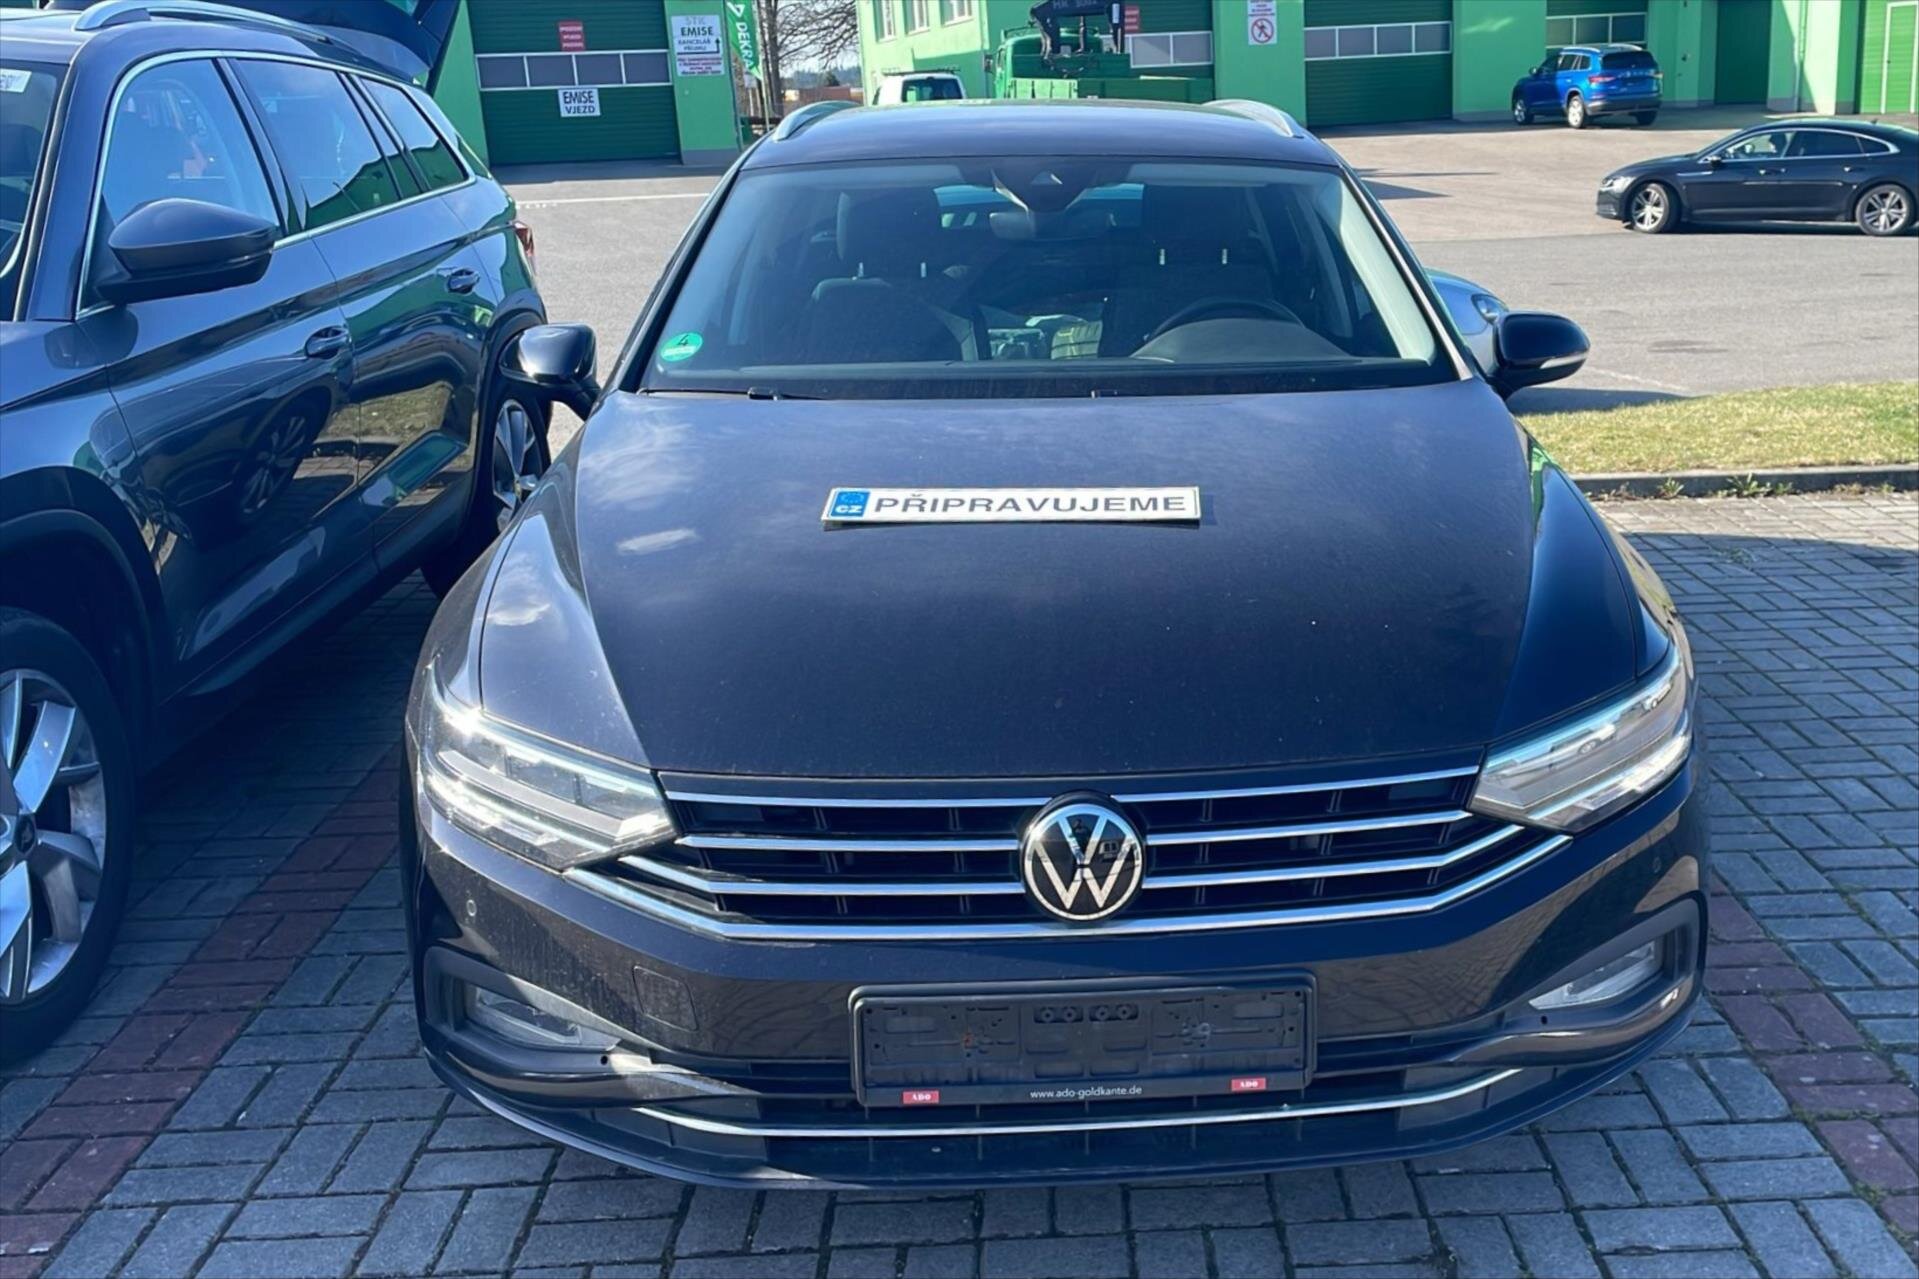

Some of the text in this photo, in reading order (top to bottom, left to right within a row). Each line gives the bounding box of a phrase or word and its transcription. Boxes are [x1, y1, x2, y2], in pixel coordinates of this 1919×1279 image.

[680, 26, 714, 37] EMISE
[736, 22, 754, 69] DEKRA
[563, 91, 594, 104] EMISE
[565, 105, 596, 114] VJEZD
[676, 334, 689, 346] 4
[835, 493, 1186, 515] CZ PŘIPRAVUJEME
[1239, 1080, 1259, 1089] ADO
[911, 1093, 932, 1102] ADO
[1030, 1085, 1143, 1099] www.ado-goldkante.de
